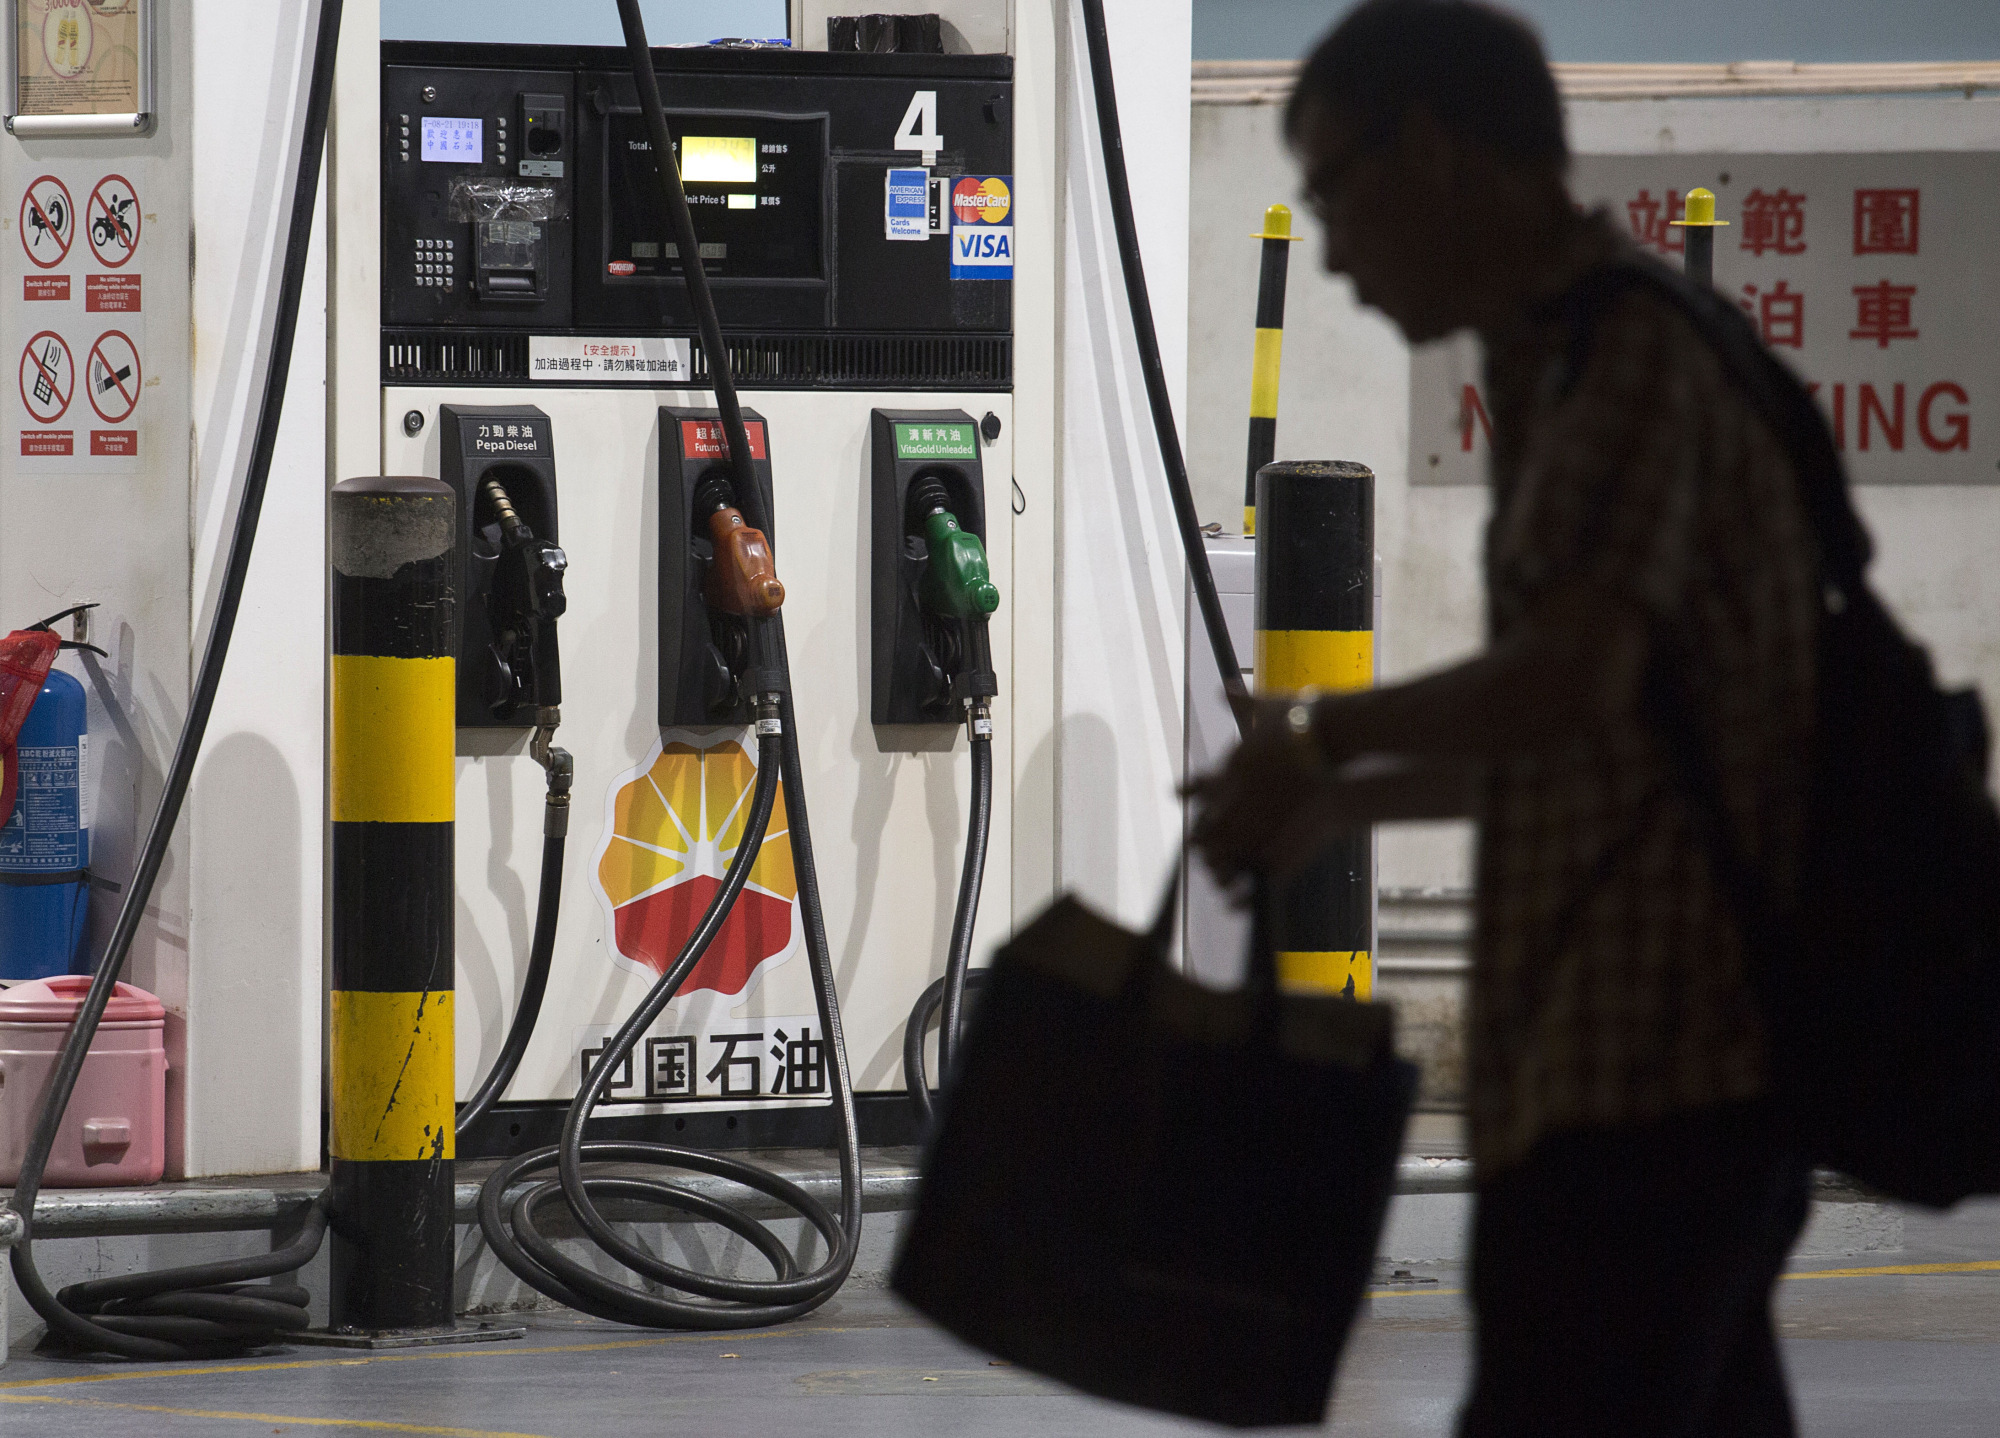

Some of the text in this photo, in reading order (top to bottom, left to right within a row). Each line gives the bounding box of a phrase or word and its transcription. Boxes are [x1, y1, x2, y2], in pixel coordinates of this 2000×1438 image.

[894, 91, 944, 166] 4
[426, 140, 474, 151] 中國石油
[628, 141, 648, 150] Total
[761, 164, 776, 173] 公升
[889, 186, 923, 194] AMERICAN
[700, 195, 719, 204] Price
[720, 194, 726, 205] $
[896, 195, 925, 204] EXPRESS
[954, 193, 1009, 208] MasterCard
[891, 227, 921, 235] Welcome
[956, 234, 1010, 258] VISA
[583, 344, 636, 357] 【安全提示】
[479, 425, 533, 437] 力勁柴油
[107, 435, 128, 443] smoking
[477, 440, 537, 452] Pepa Diesel
[695, 443, 719, 451] Futuro
[901, 445, 972, 453] VitaGold Unleaded
[581, 1027, 825, 1102] 中国石油
